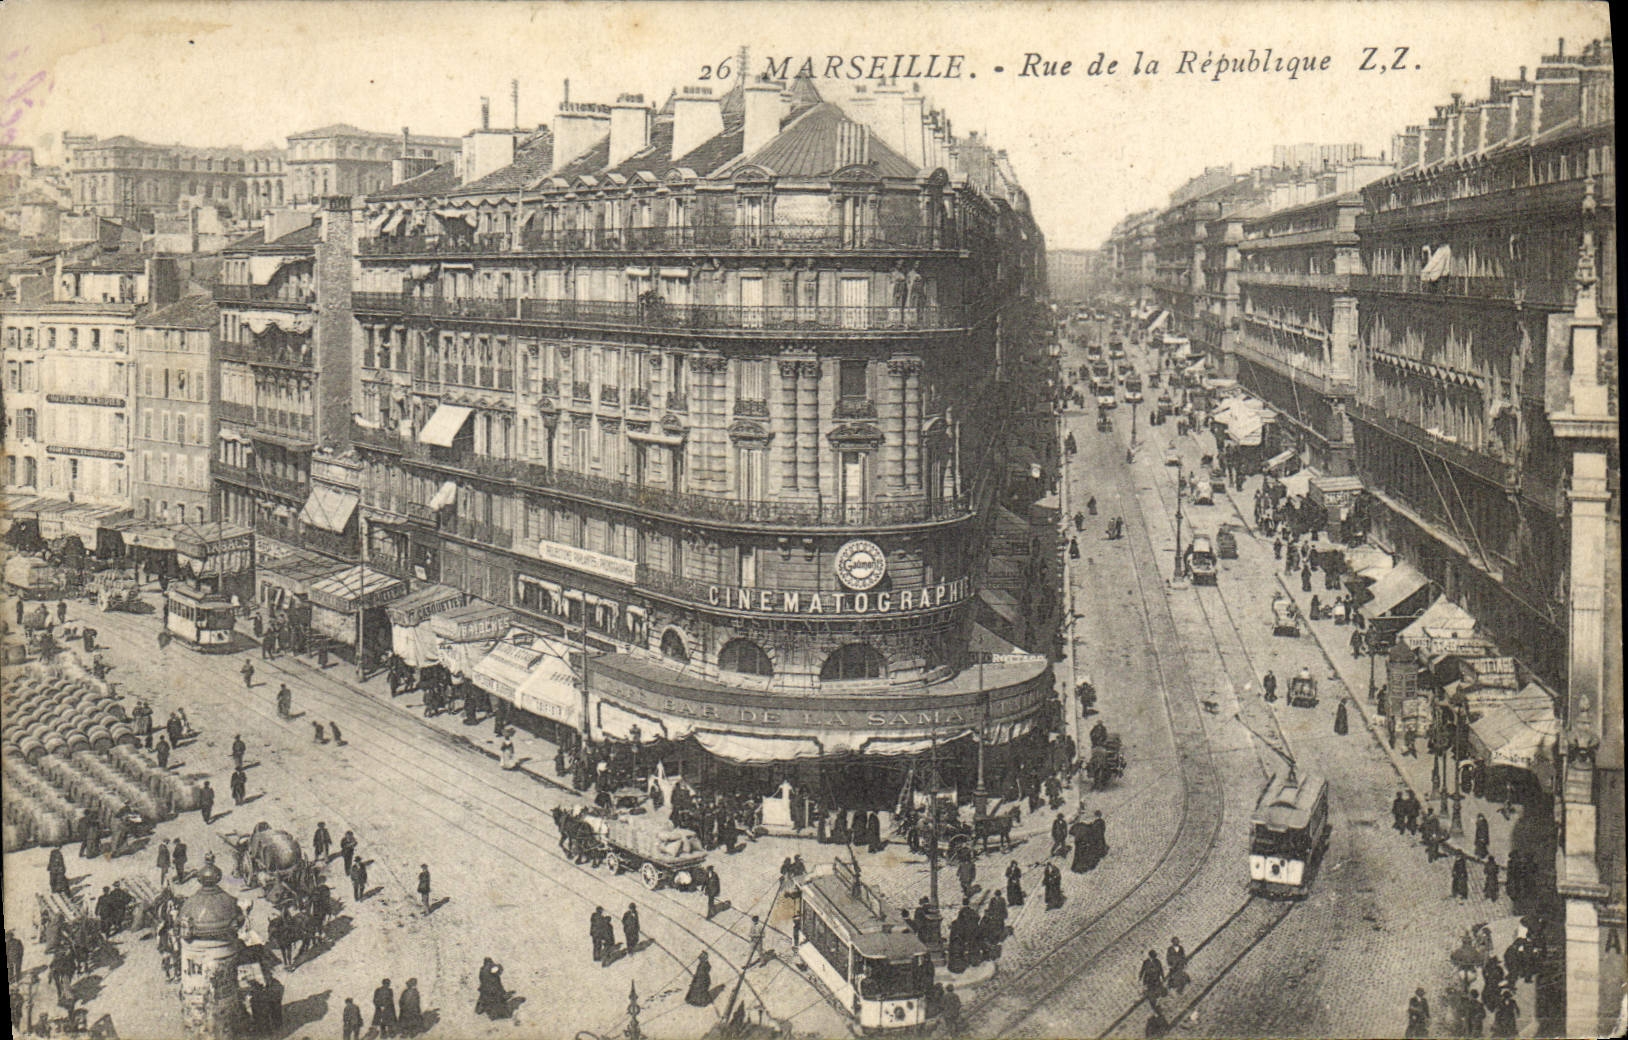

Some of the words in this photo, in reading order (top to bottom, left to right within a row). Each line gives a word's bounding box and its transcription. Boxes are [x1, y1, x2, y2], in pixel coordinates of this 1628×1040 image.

[662, 699, 720, 719] BAR
[740, 710, 781, 724] DE
[804, 712, 848, 726] LA
